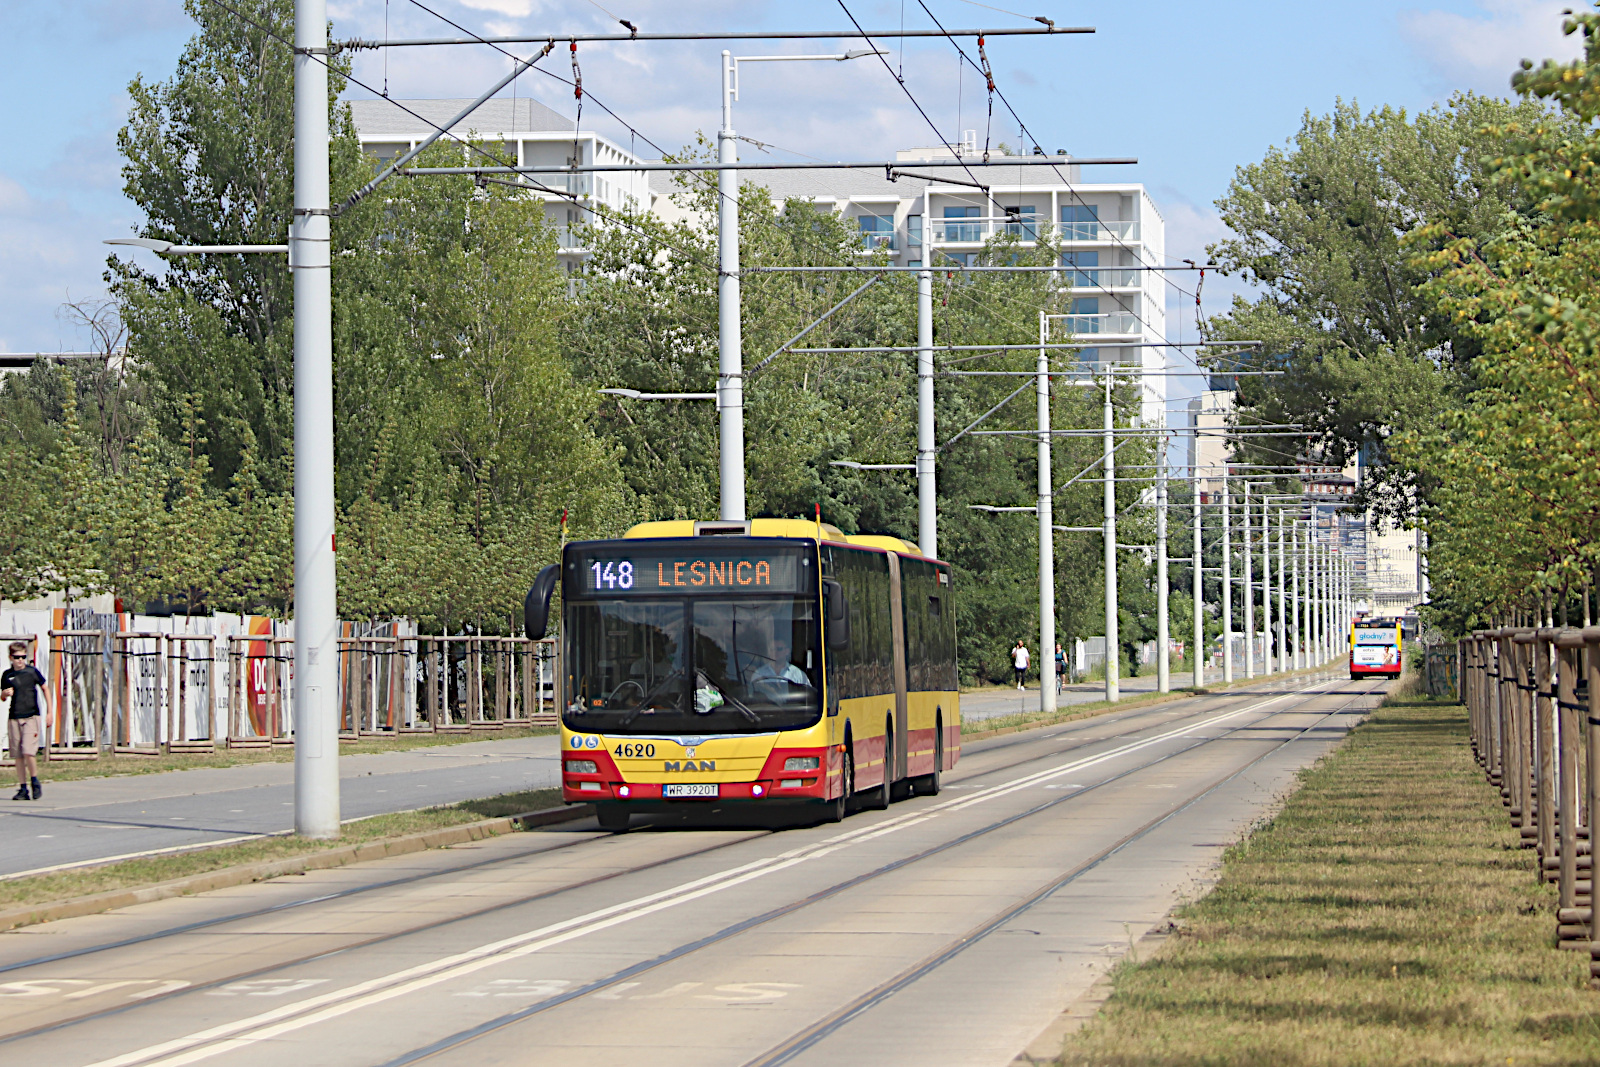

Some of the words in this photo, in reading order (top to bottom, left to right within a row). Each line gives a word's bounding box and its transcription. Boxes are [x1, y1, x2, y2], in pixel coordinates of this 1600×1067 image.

[591, 560, 633, 590] 148
[614, 743, 656, 758] 4620
[664, 760, 716, 772] MAN
[668, 785, 683, 795] WR
[687, 785, 717, 796] 3920T
[450, 978, 805, 1001] BUS
